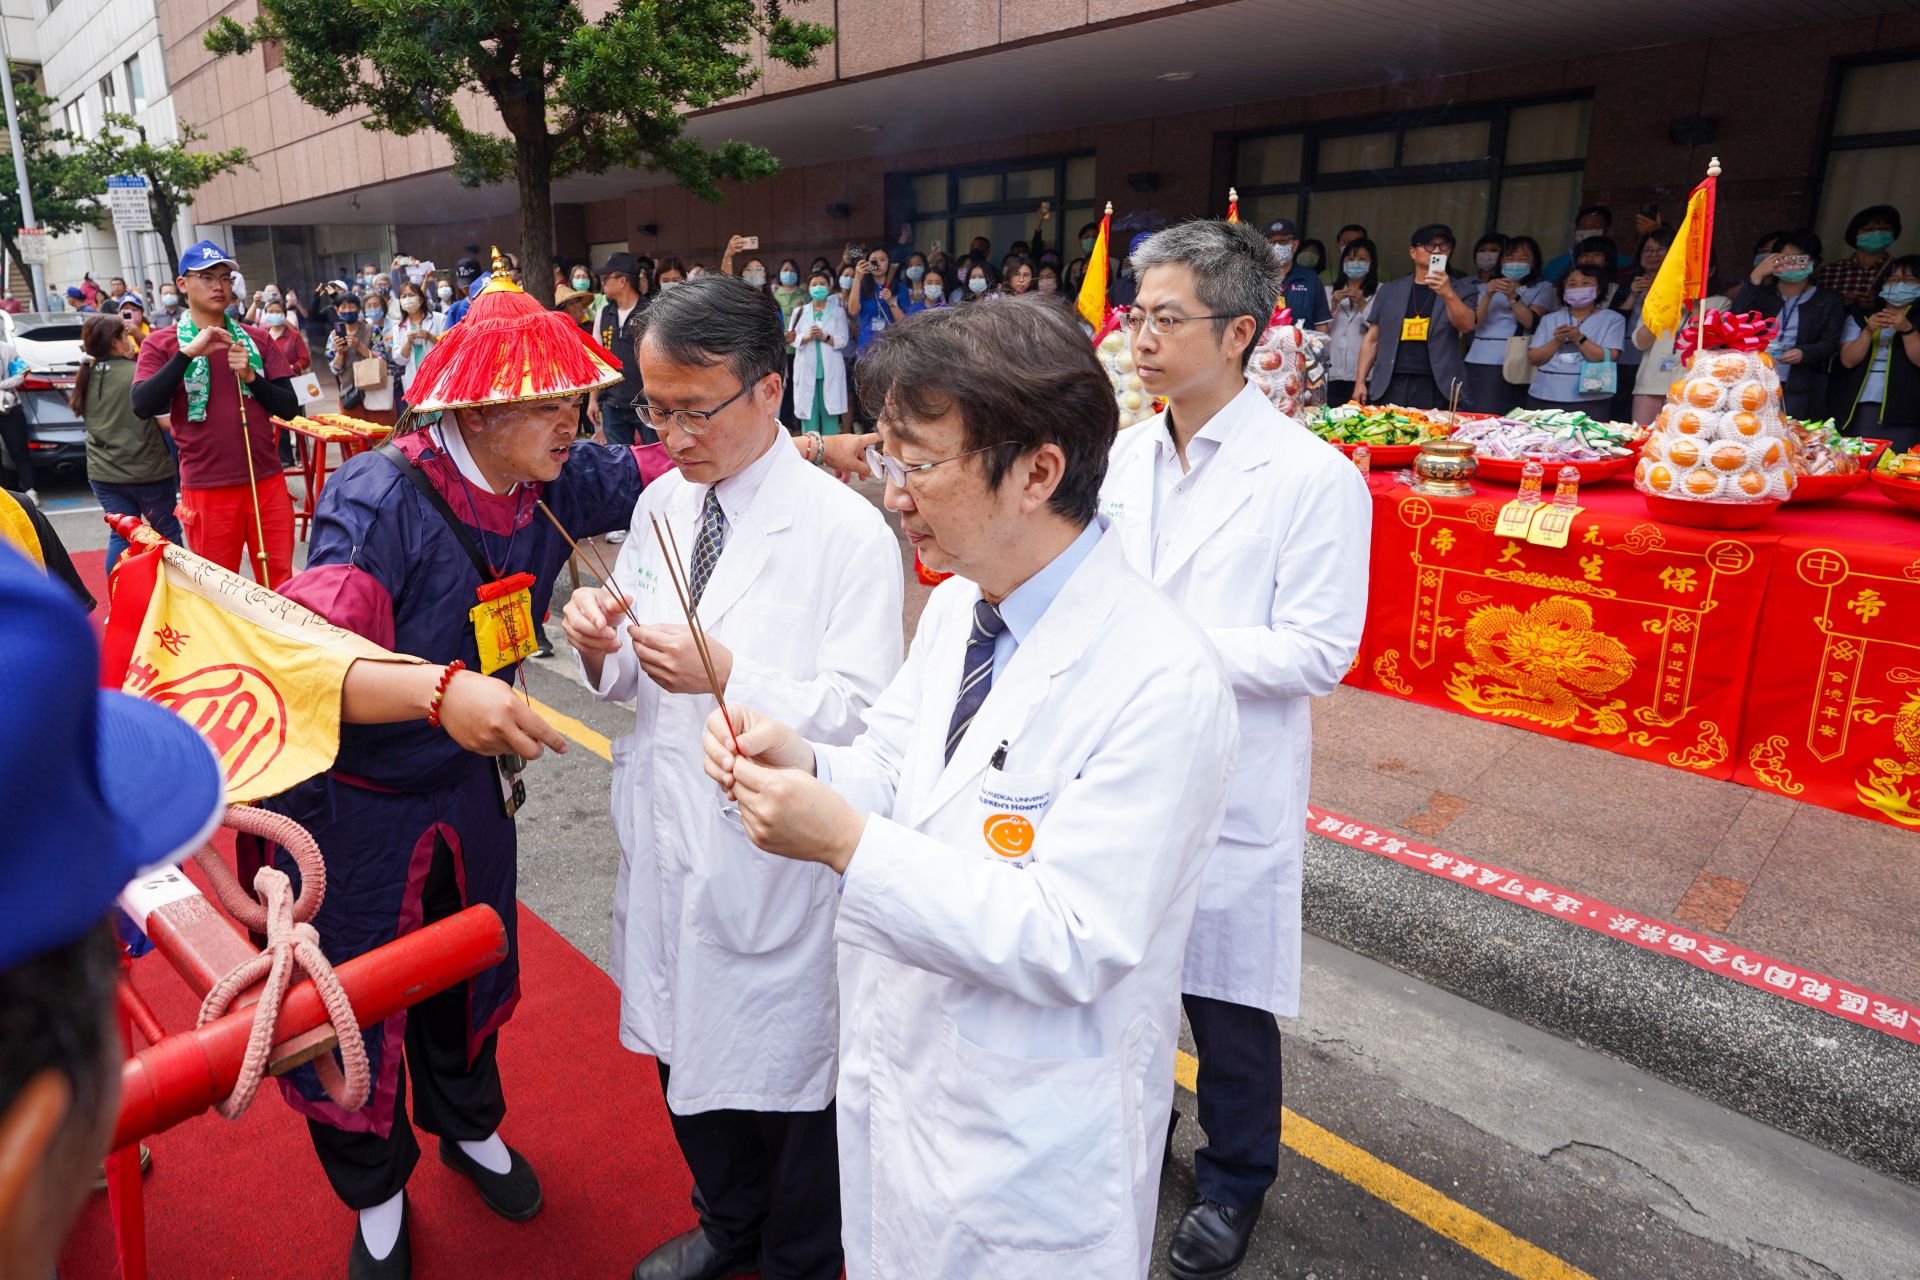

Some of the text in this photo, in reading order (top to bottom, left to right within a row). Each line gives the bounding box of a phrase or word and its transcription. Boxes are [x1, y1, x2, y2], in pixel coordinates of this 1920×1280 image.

[1404, 502, 1426, 522] 中
[1582, 525, 1605, 546] 元
[1715, 545, 1744, 568] 台
[1806, 554, 1841, 581] 中
[1847, 588, 1886, 624] 帝
